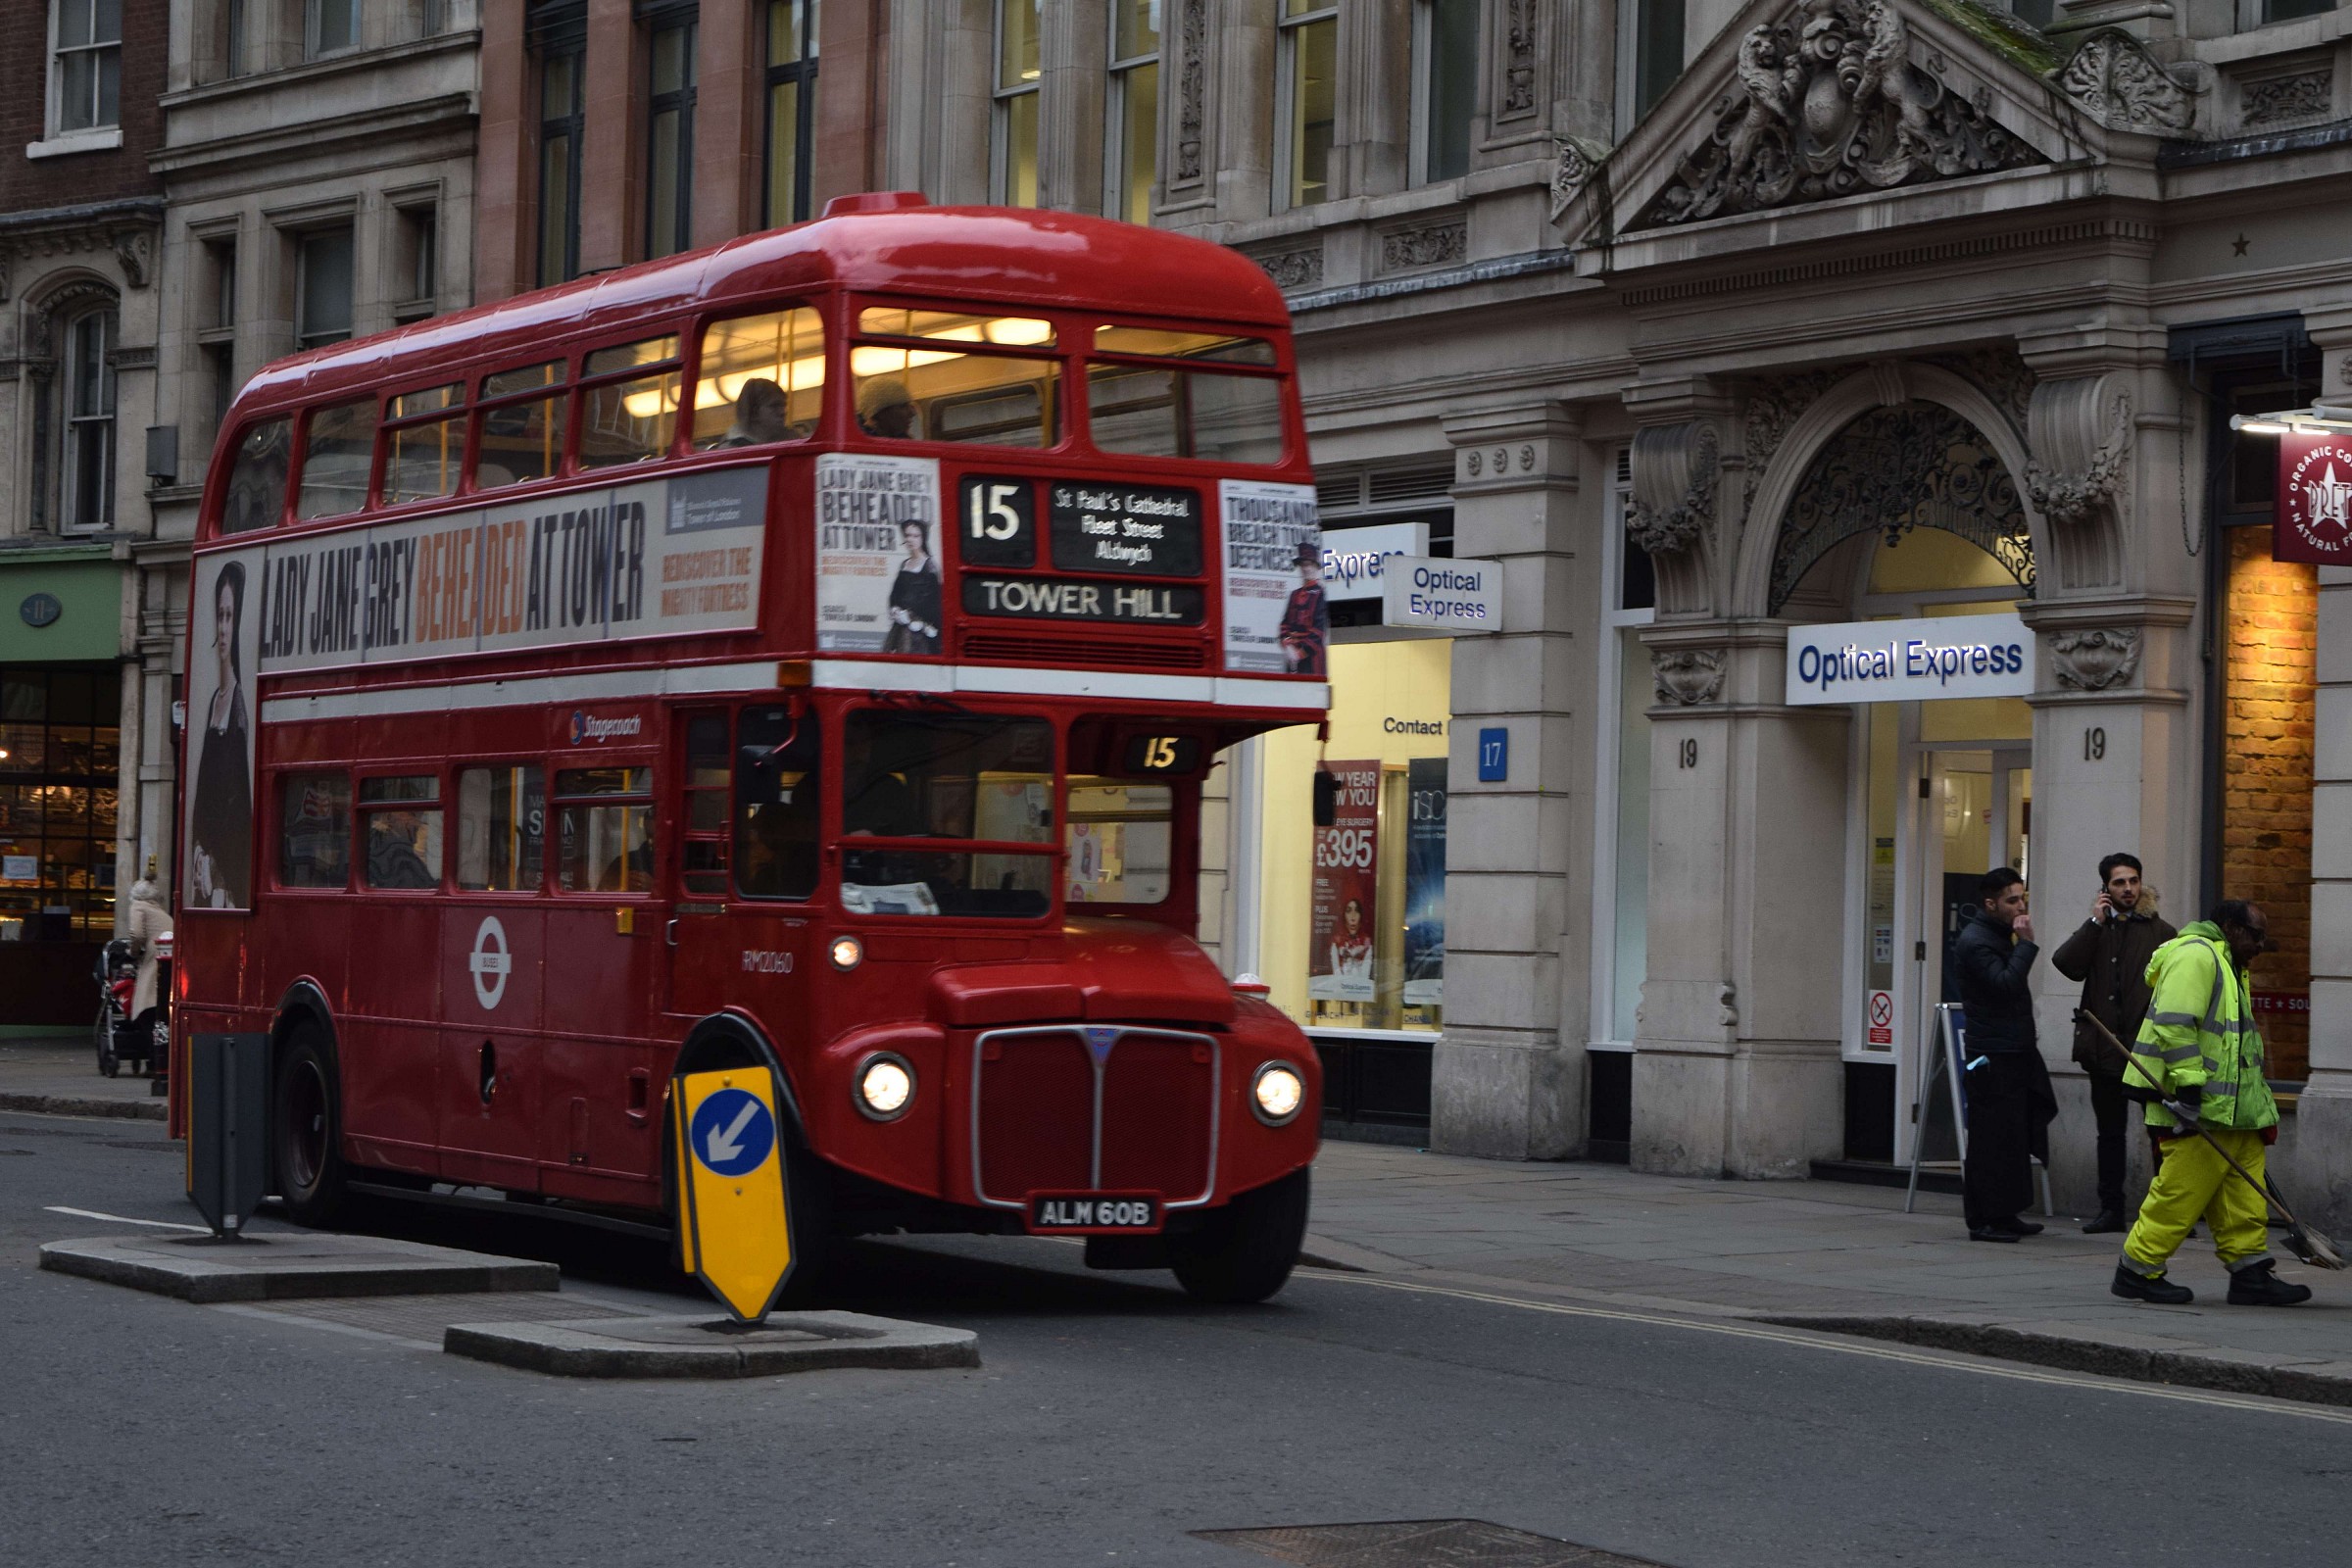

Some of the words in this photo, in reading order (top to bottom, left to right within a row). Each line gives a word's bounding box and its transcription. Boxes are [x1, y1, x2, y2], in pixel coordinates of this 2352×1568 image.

[822, 468, 858, 491] LADY
[858, 469, 894, 492] JANE
[897, 470, 933, 494] GREY
[2288, 446, 2332, 492] ORGANIC
[823, 491, 934, 525] BEHEADED
[969, 484, 1020, 540] 15
[1054, 488, 1072, 508] St
[1076, 490, 1121, 512] Paul's
[1124, 494, 1190, 517] Cathedral
[2308, 479, 2352, 520] PRET
[1082, 514, 1118, 536] Fleet
[1122, 517, 1164, 539] Street
[2291, 513, 2340, 552] NATURAL
[728, 546, 753, 577] THE
[1095, 540, 1152, 566] Aldwych
[259, 553, 312, 660] LADY
[310, 545, 363, 656] JANE
[365, 536, 418, 650] GREY
[416, 518, 527, 644] BEHEADED
[526, 514, 559, 632] AT
[561, 501, 646, 628] TOWER
[1323, 549, 1405, 589] Expre
[1414, 567, 1481, 594] Optical
[981, 581, 1102, 616] TOWER
[1113, 587, 1183, 619] HILL
[1410, 594, 1486, 621] Express
[1798, 640, 1897, 692] Optical
[1906, 638, 2024, 687] Express
[584, 713, 641, 743] Stagecoach
[1384, 716, 1444, 736] Contact
[1144, 737, 1180, 768] 15
[1484, 742, 1501, 767] 17
[1679, 738, 1698, 769] 19
[2084, 726, 2106, 761] 19
[1348, 771, 1376, 788] YEAR
[1350, 789, 1376, 807] YOU
[1413, 790, 1446, 821] iSC
[1316, 829, 1374, 868] £395
[742, 950, 794, 973] RM2060
[2251, 997, 2271, 1009] TTE
[1039, 1200, 1094, 1225] ALM
[1096, 1200, 1151, 1225] 60B
